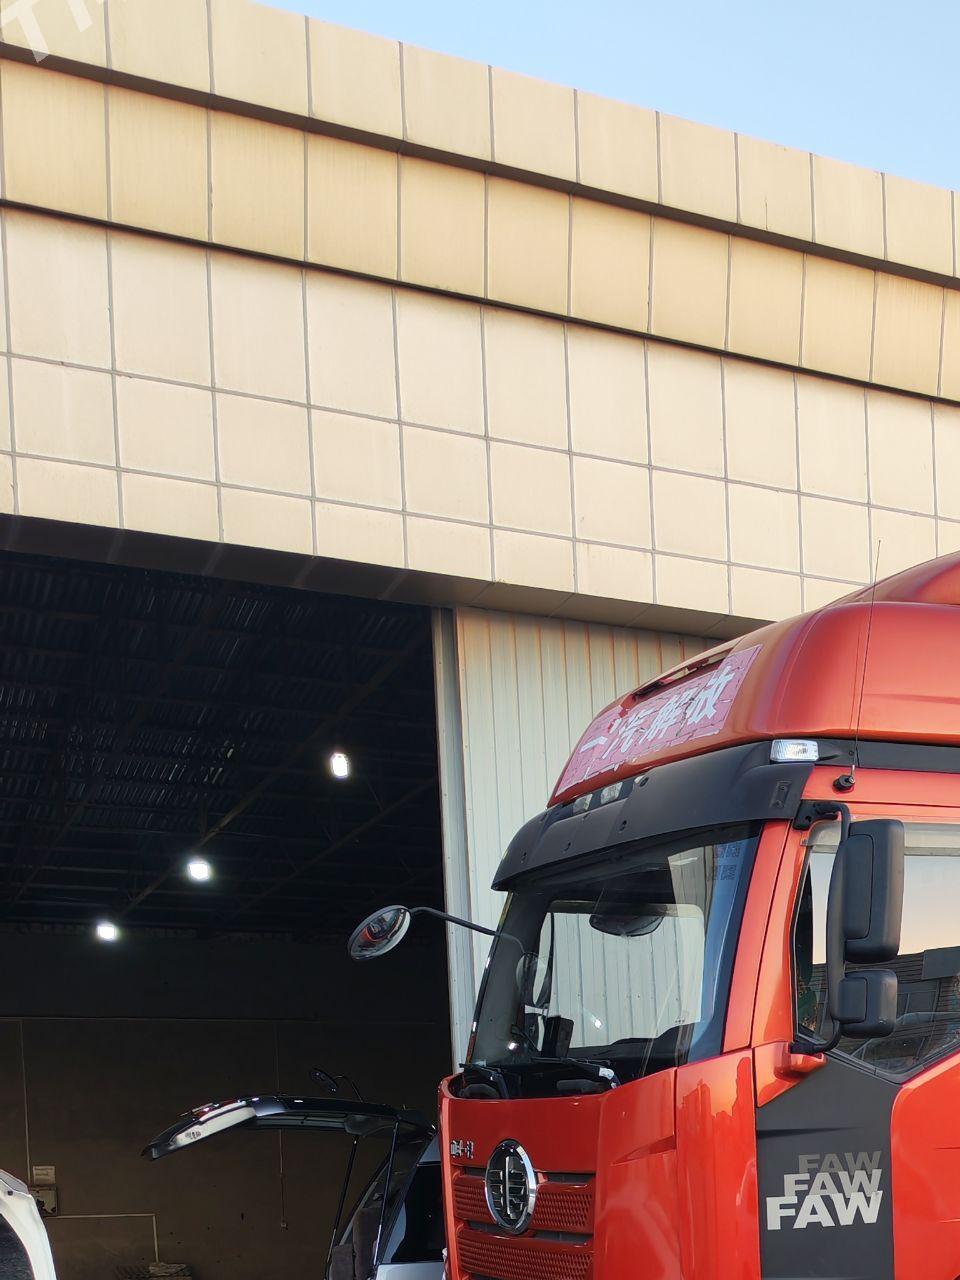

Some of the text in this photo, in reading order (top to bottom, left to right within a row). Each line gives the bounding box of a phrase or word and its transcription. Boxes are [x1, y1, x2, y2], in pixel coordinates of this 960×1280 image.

[799, 1150, 882, 1175] FAW
[784, 1168, 882, 1198] FAW
[766, 1190, 883, 1230] FAW
